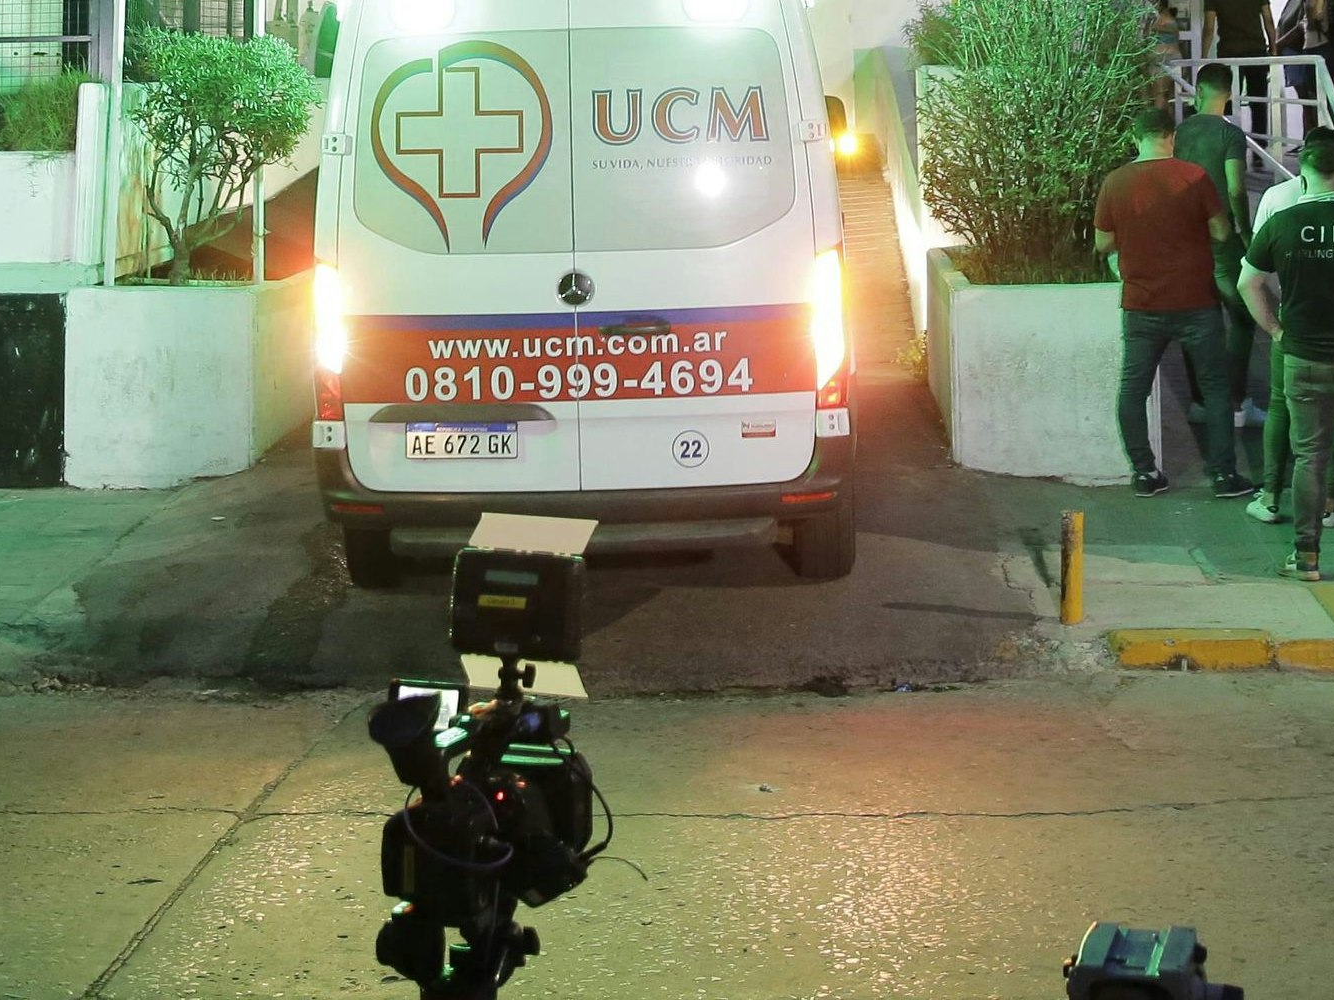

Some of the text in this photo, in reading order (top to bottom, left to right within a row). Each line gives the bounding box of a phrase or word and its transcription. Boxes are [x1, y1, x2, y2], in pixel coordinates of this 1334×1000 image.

[592, 86, 770, 146] UCM
[592, 159, 607, 170] SU
[610, 158, 644, 171] VIDA,
[428, 327, 728, 361] www.ucm.com.ar
[404, 358, 754, 402] 0810-999-4694
[412, 434, 512, 455] AE 672 GK
[680, 440, 702, 459] 22
